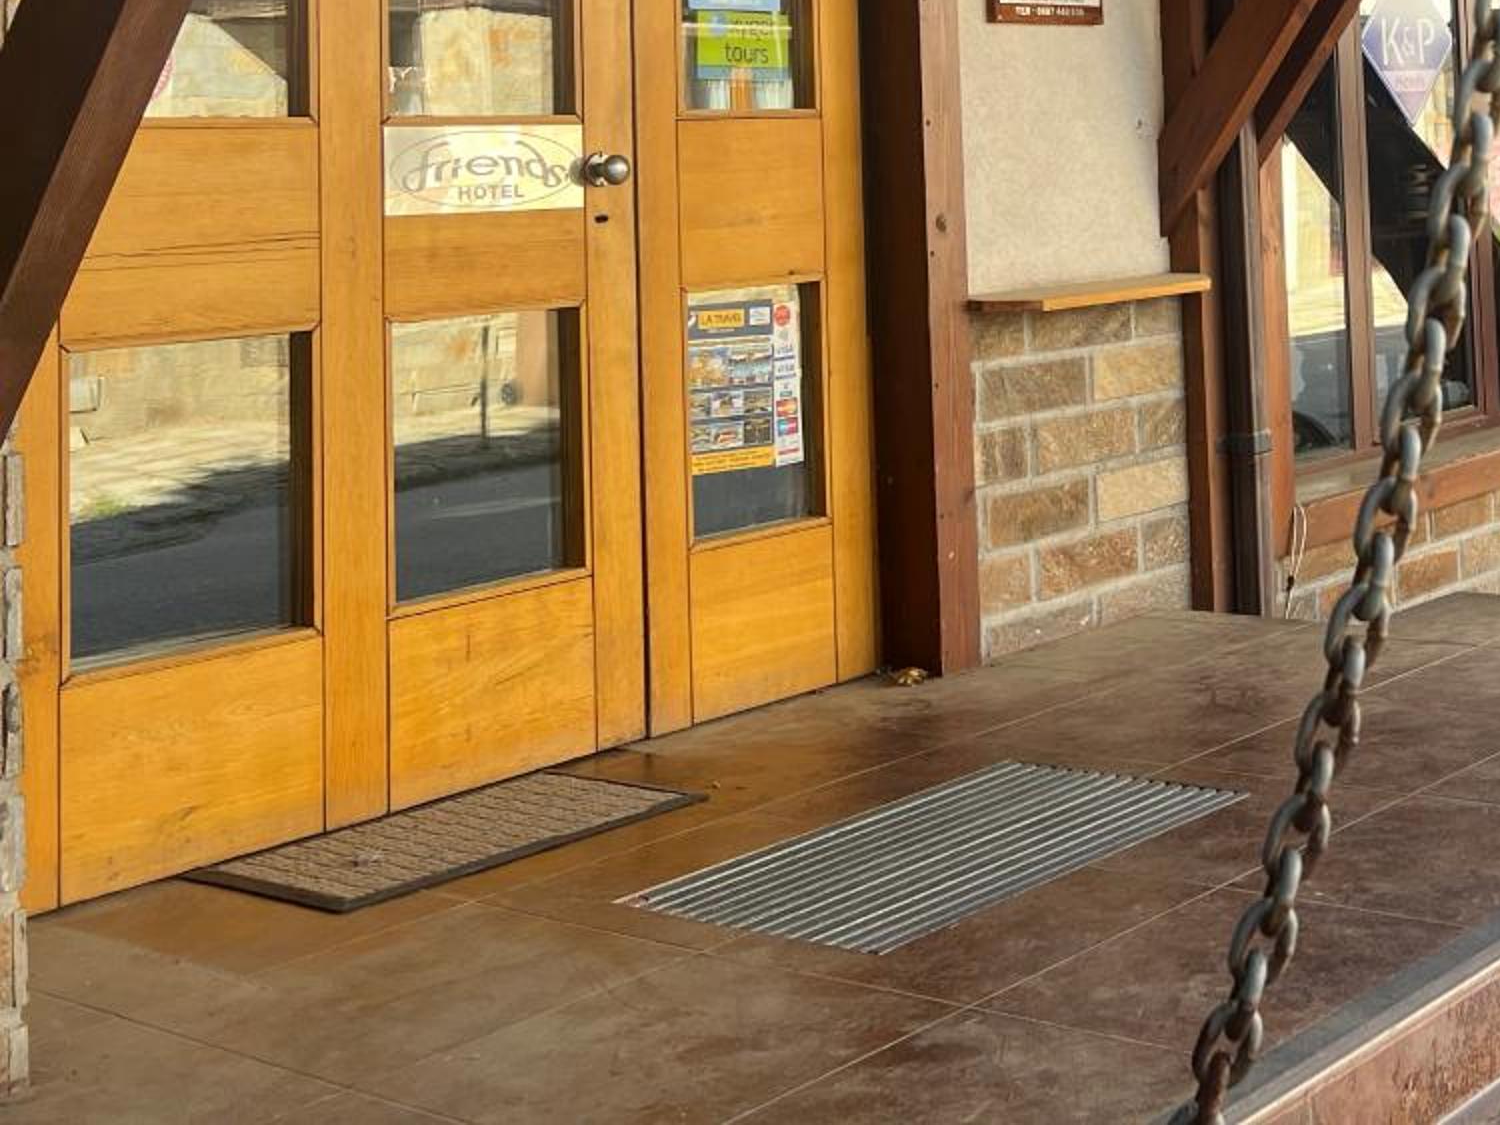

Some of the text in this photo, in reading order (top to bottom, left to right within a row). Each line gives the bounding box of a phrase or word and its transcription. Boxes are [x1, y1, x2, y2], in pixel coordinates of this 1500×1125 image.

[725, 42, 769, 65] tours
[1379, 16, 1435, 66] K&P
[402, 140, 569, 192] friends
[458, 184, 525, 204] HOTEL
